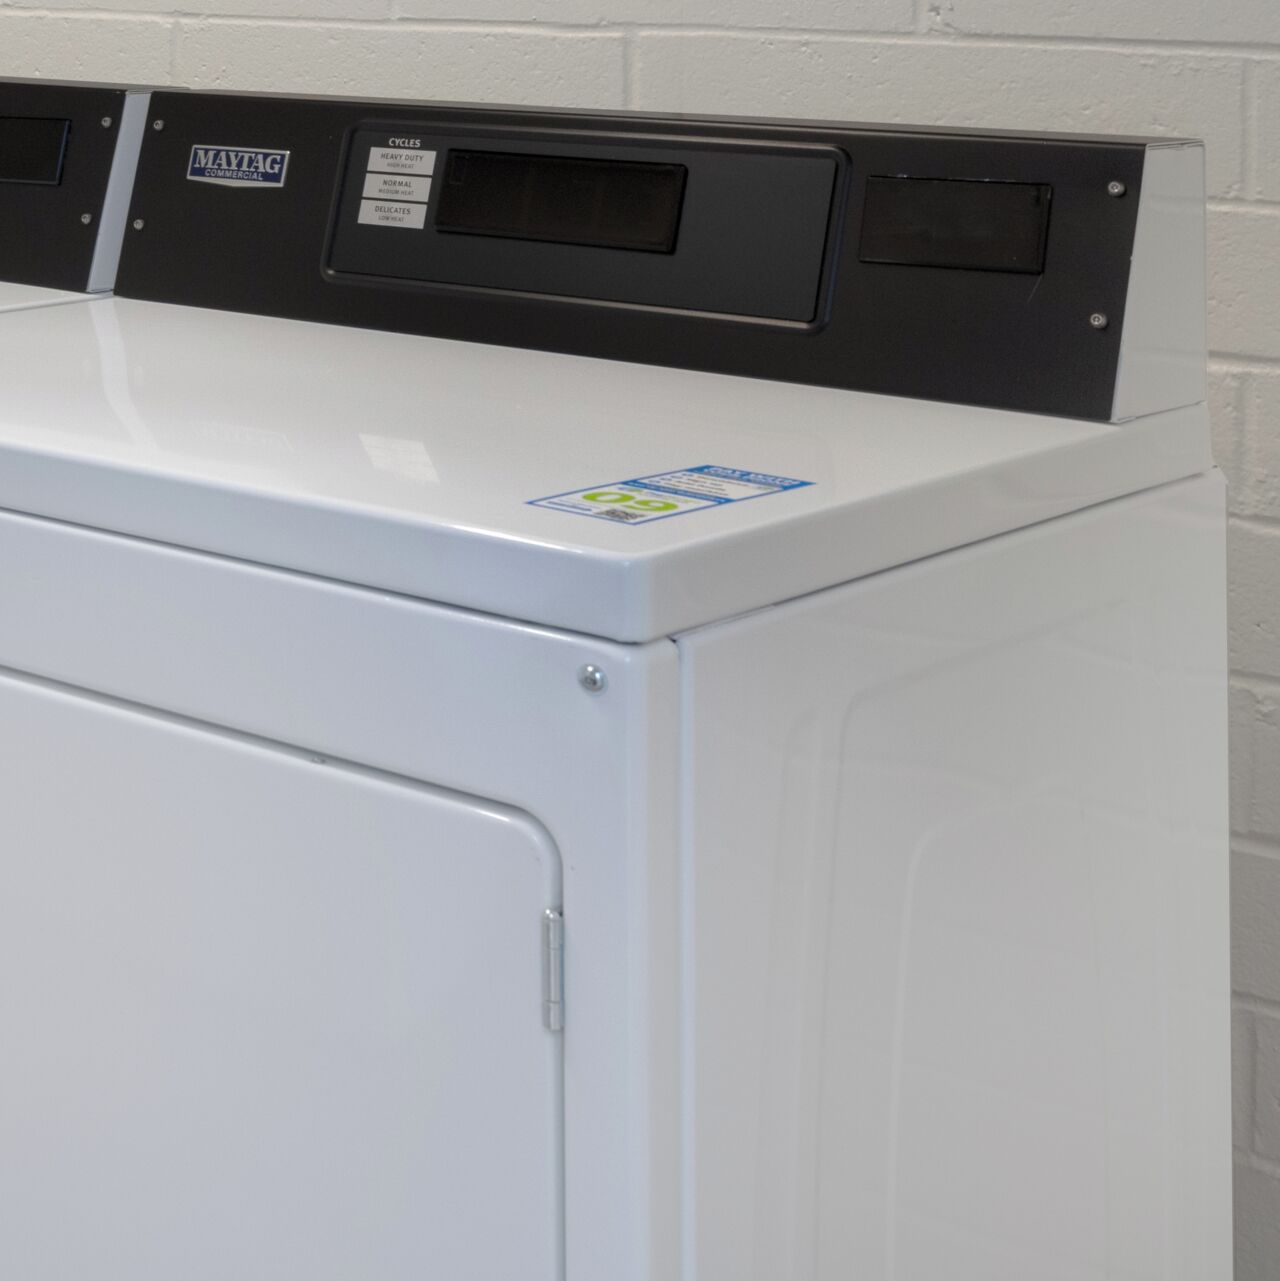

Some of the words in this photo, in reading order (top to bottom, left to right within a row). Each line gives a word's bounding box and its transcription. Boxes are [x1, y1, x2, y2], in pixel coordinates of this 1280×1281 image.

[389, 137, 421, 148] CYCLES
[193, 149, 281, 174] MAYTAG
[380, 152, 403, 161] HEAVY
[404, 154, 425, 162] DUTY
[204, 168, 264, 181] COMMERCIAL
[382, 179, 412, 188] NORMAL
[374, 205, 412, 215] DELICATES
[581, 491, 679, 512] 09
